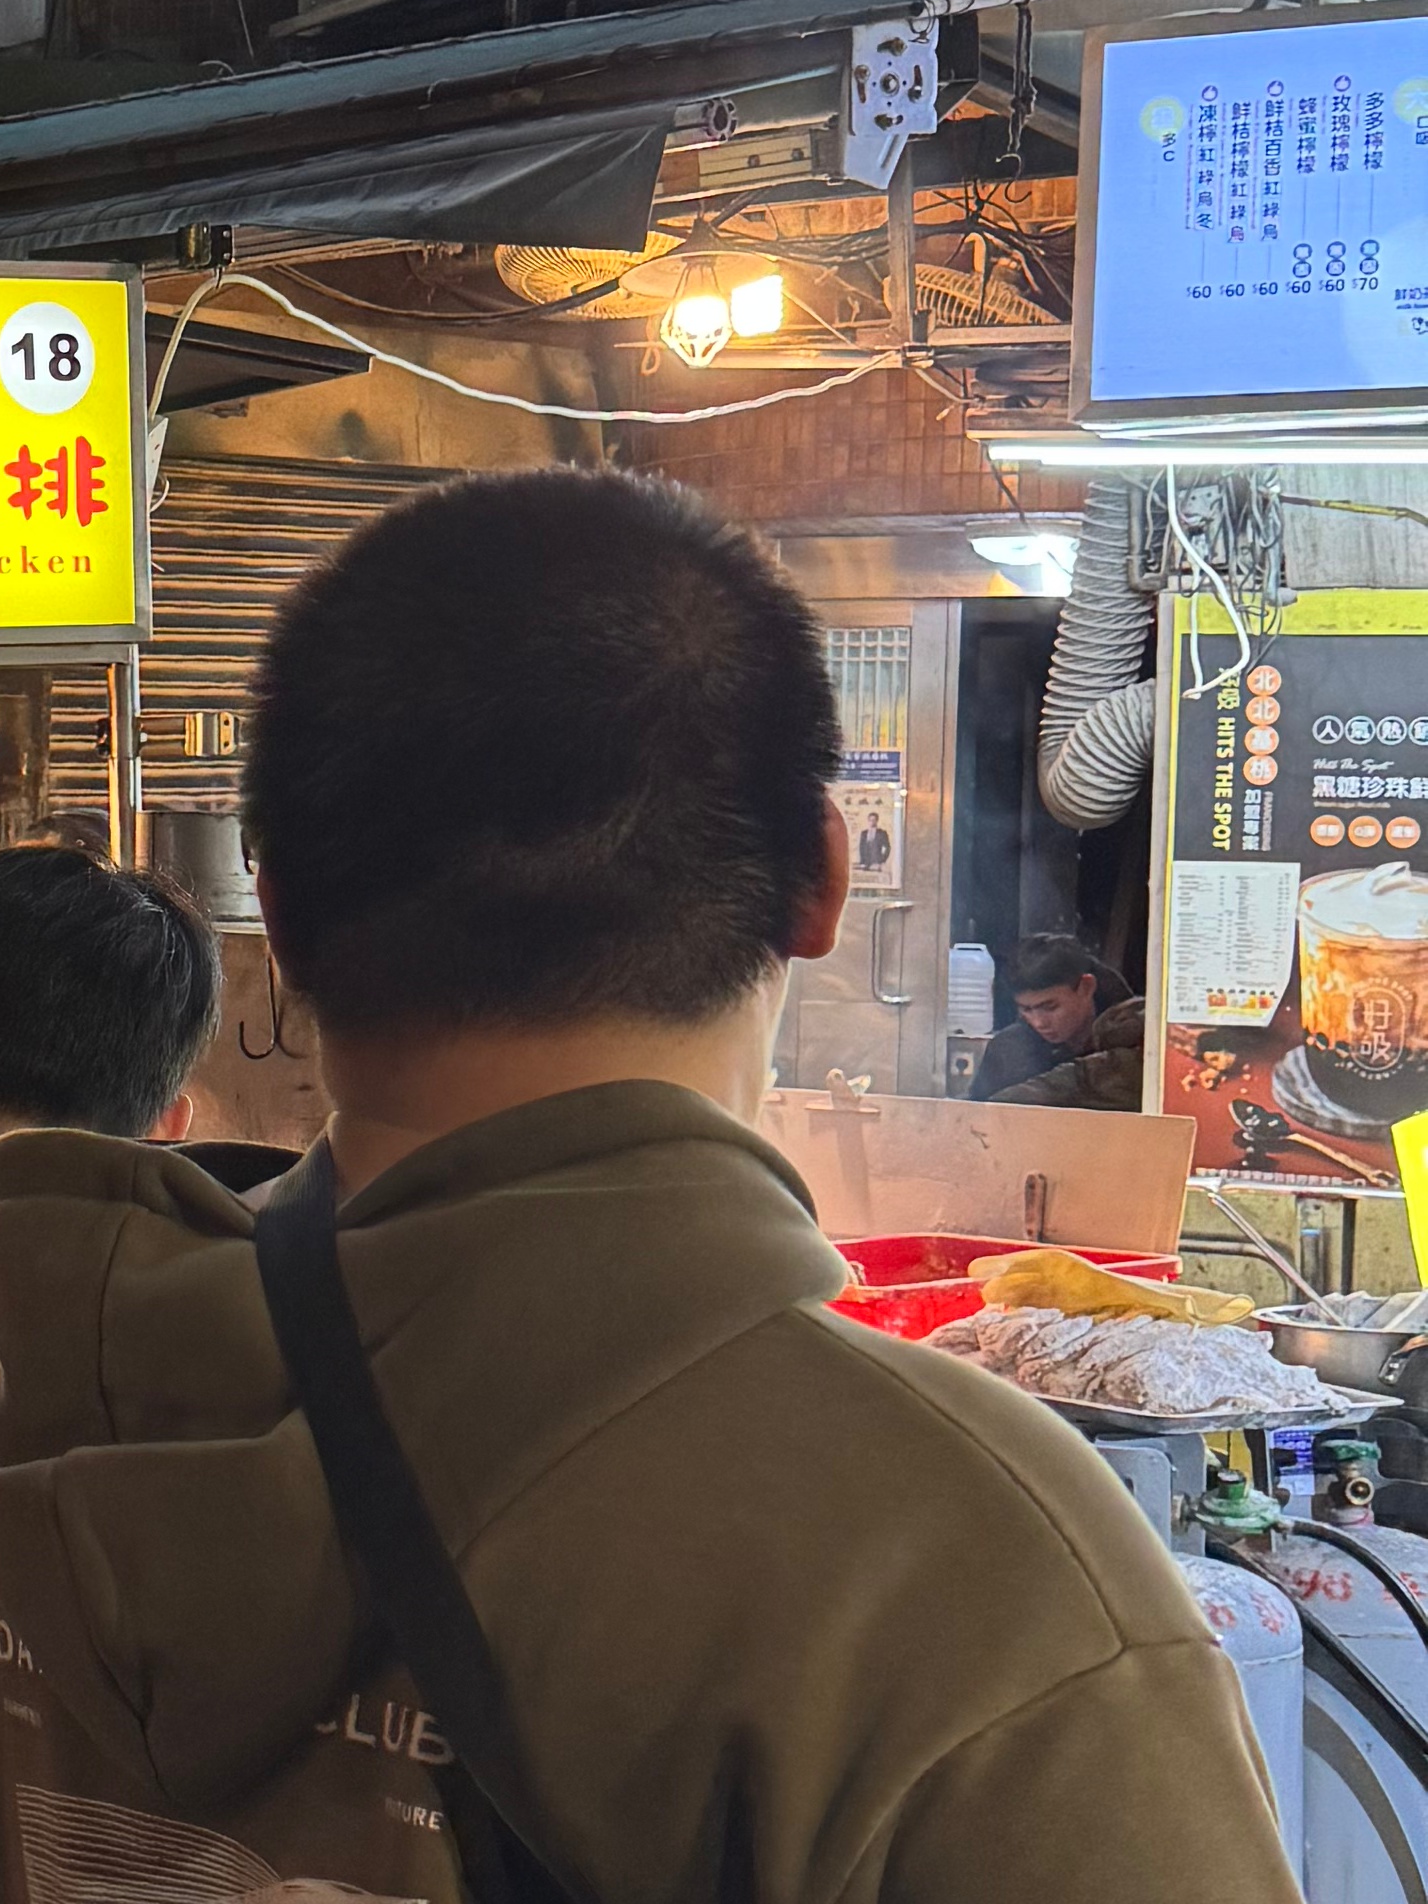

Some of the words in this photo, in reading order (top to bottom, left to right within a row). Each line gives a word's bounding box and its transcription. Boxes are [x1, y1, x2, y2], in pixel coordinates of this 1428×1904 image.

[10, 333, 81, 382] 18
[1216, 717, 1236, 759] HITS
[1214, 762, 1234, 799] THE
[1212, 802, 1232, 852] SPOT
